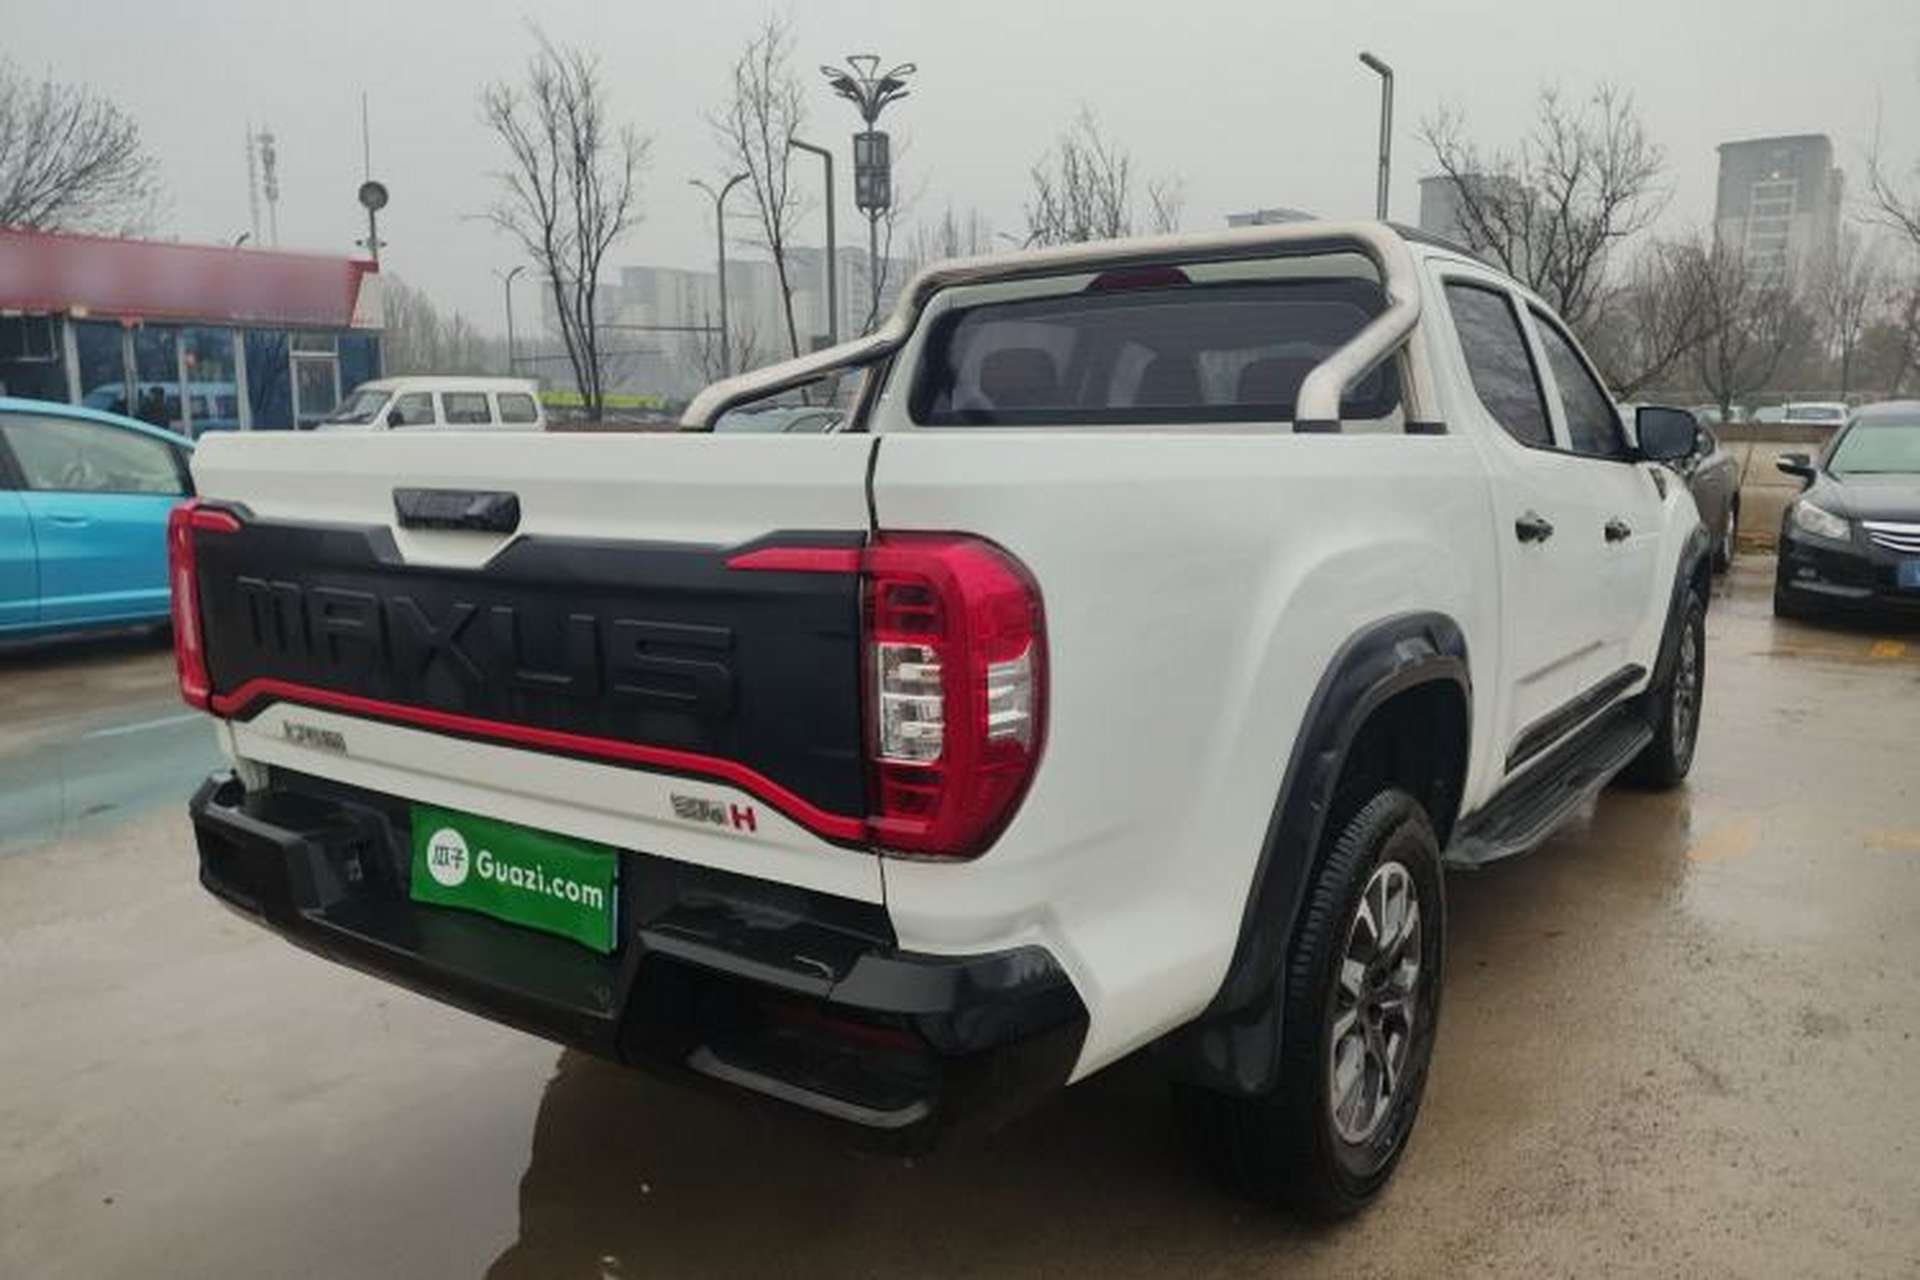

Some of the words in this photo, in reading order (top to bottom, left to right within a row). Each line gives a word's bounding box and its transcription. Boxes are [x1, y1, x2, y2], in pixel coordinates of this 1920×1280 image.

[237, 575, 739, 717] MAXUS
[433, 845, 463, 870] 瓜子
[476, 850, 604, 910] Guazi.com
